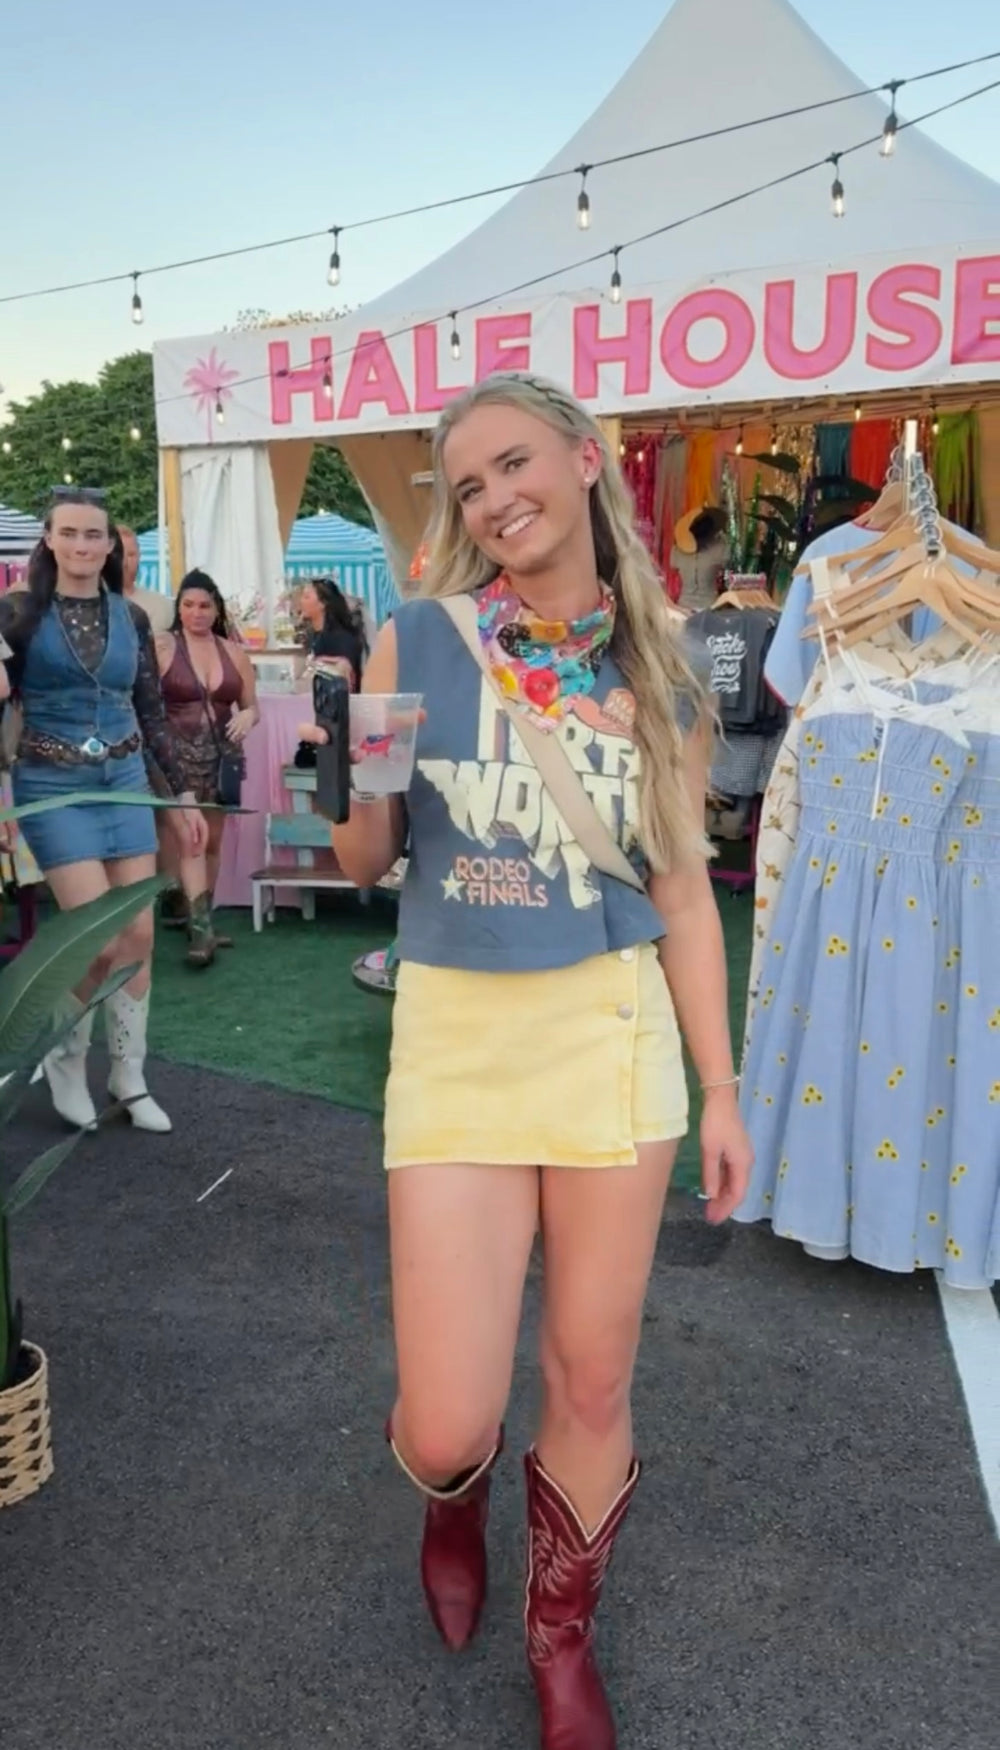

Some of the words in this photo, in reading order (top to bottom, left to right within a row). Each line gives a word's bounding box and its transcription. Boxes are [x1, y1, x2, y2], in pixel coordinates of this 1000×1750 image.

[268, 312, 532, 424] HALE
[573, 254, 1000, 399] HOUSE
[456, 856, 531, 882] RODEO
[466, 884, 548, 908] FINALS
